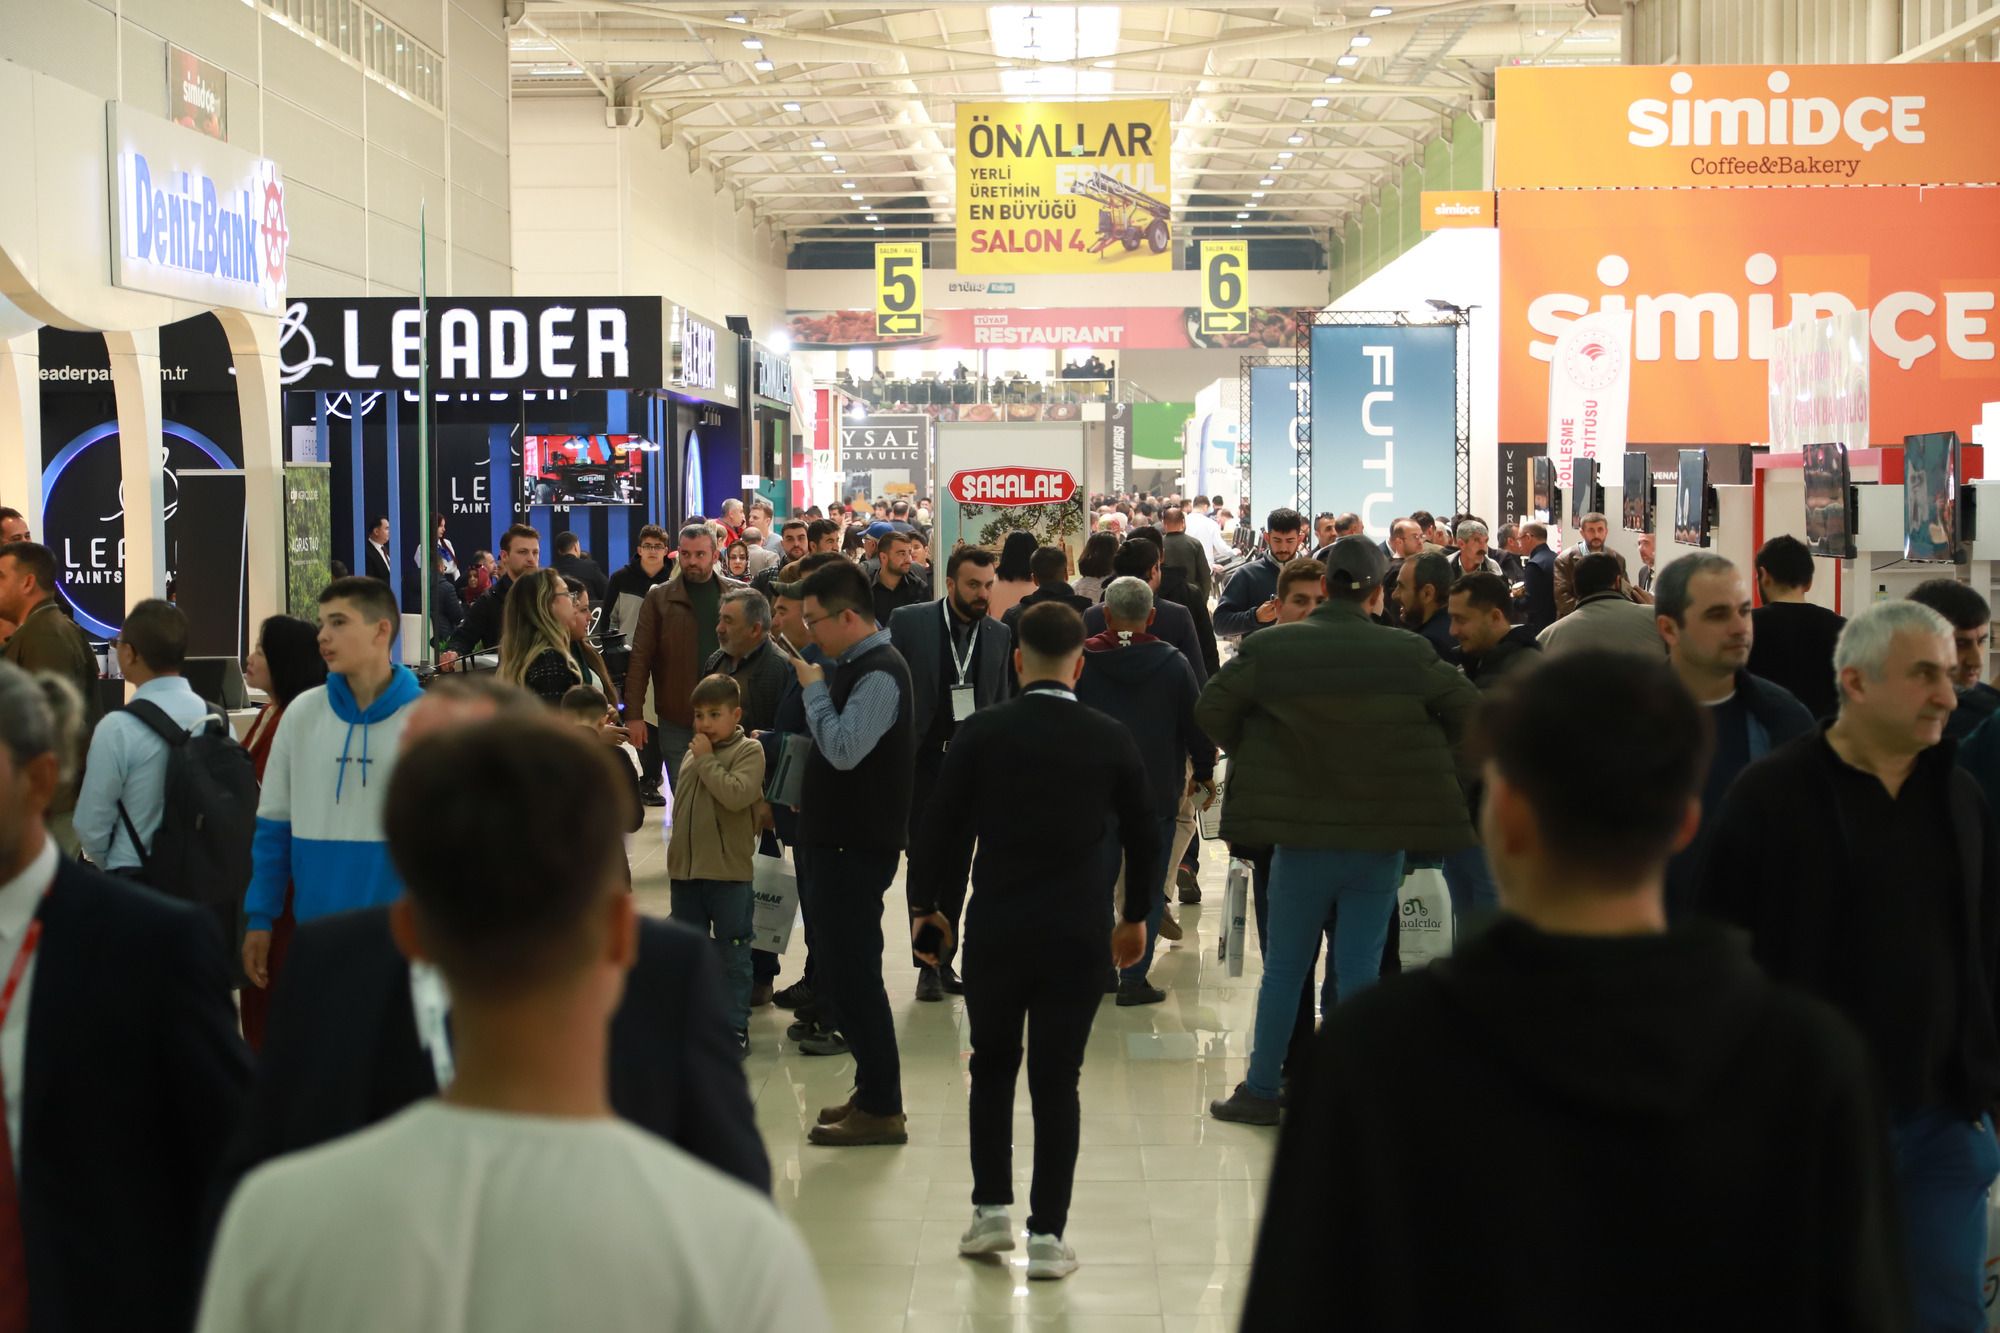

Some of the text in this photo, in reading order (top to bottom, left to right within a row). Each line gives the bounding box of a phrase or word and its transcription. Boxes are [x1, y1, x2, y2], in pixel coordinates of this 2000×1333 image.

[969, 115, 1153, 158] ÖNALLAR
[970, 165, 1012, 180] YERLİ
[1690, 155, 1861, 178] Coffee&Bakery
[970, 183, 1040, 198] ÜRETİMİN
[135, 153, 260, 284] DenizBank
[970, 199, 1077, 220] EN BÜYÜĞÜ
[970, 229, 1085, 254] SALON 4
[882, 257, 916, 312] 5
[1208, 253, 1242, 310] 6
[343, 306, 629, 379] LEADER
[974, 326, 1125, 344] RESTAURANT
[961, 474, 1063, 501] ŞAKALAK
[65, 571, 122, 584] PAINTS
